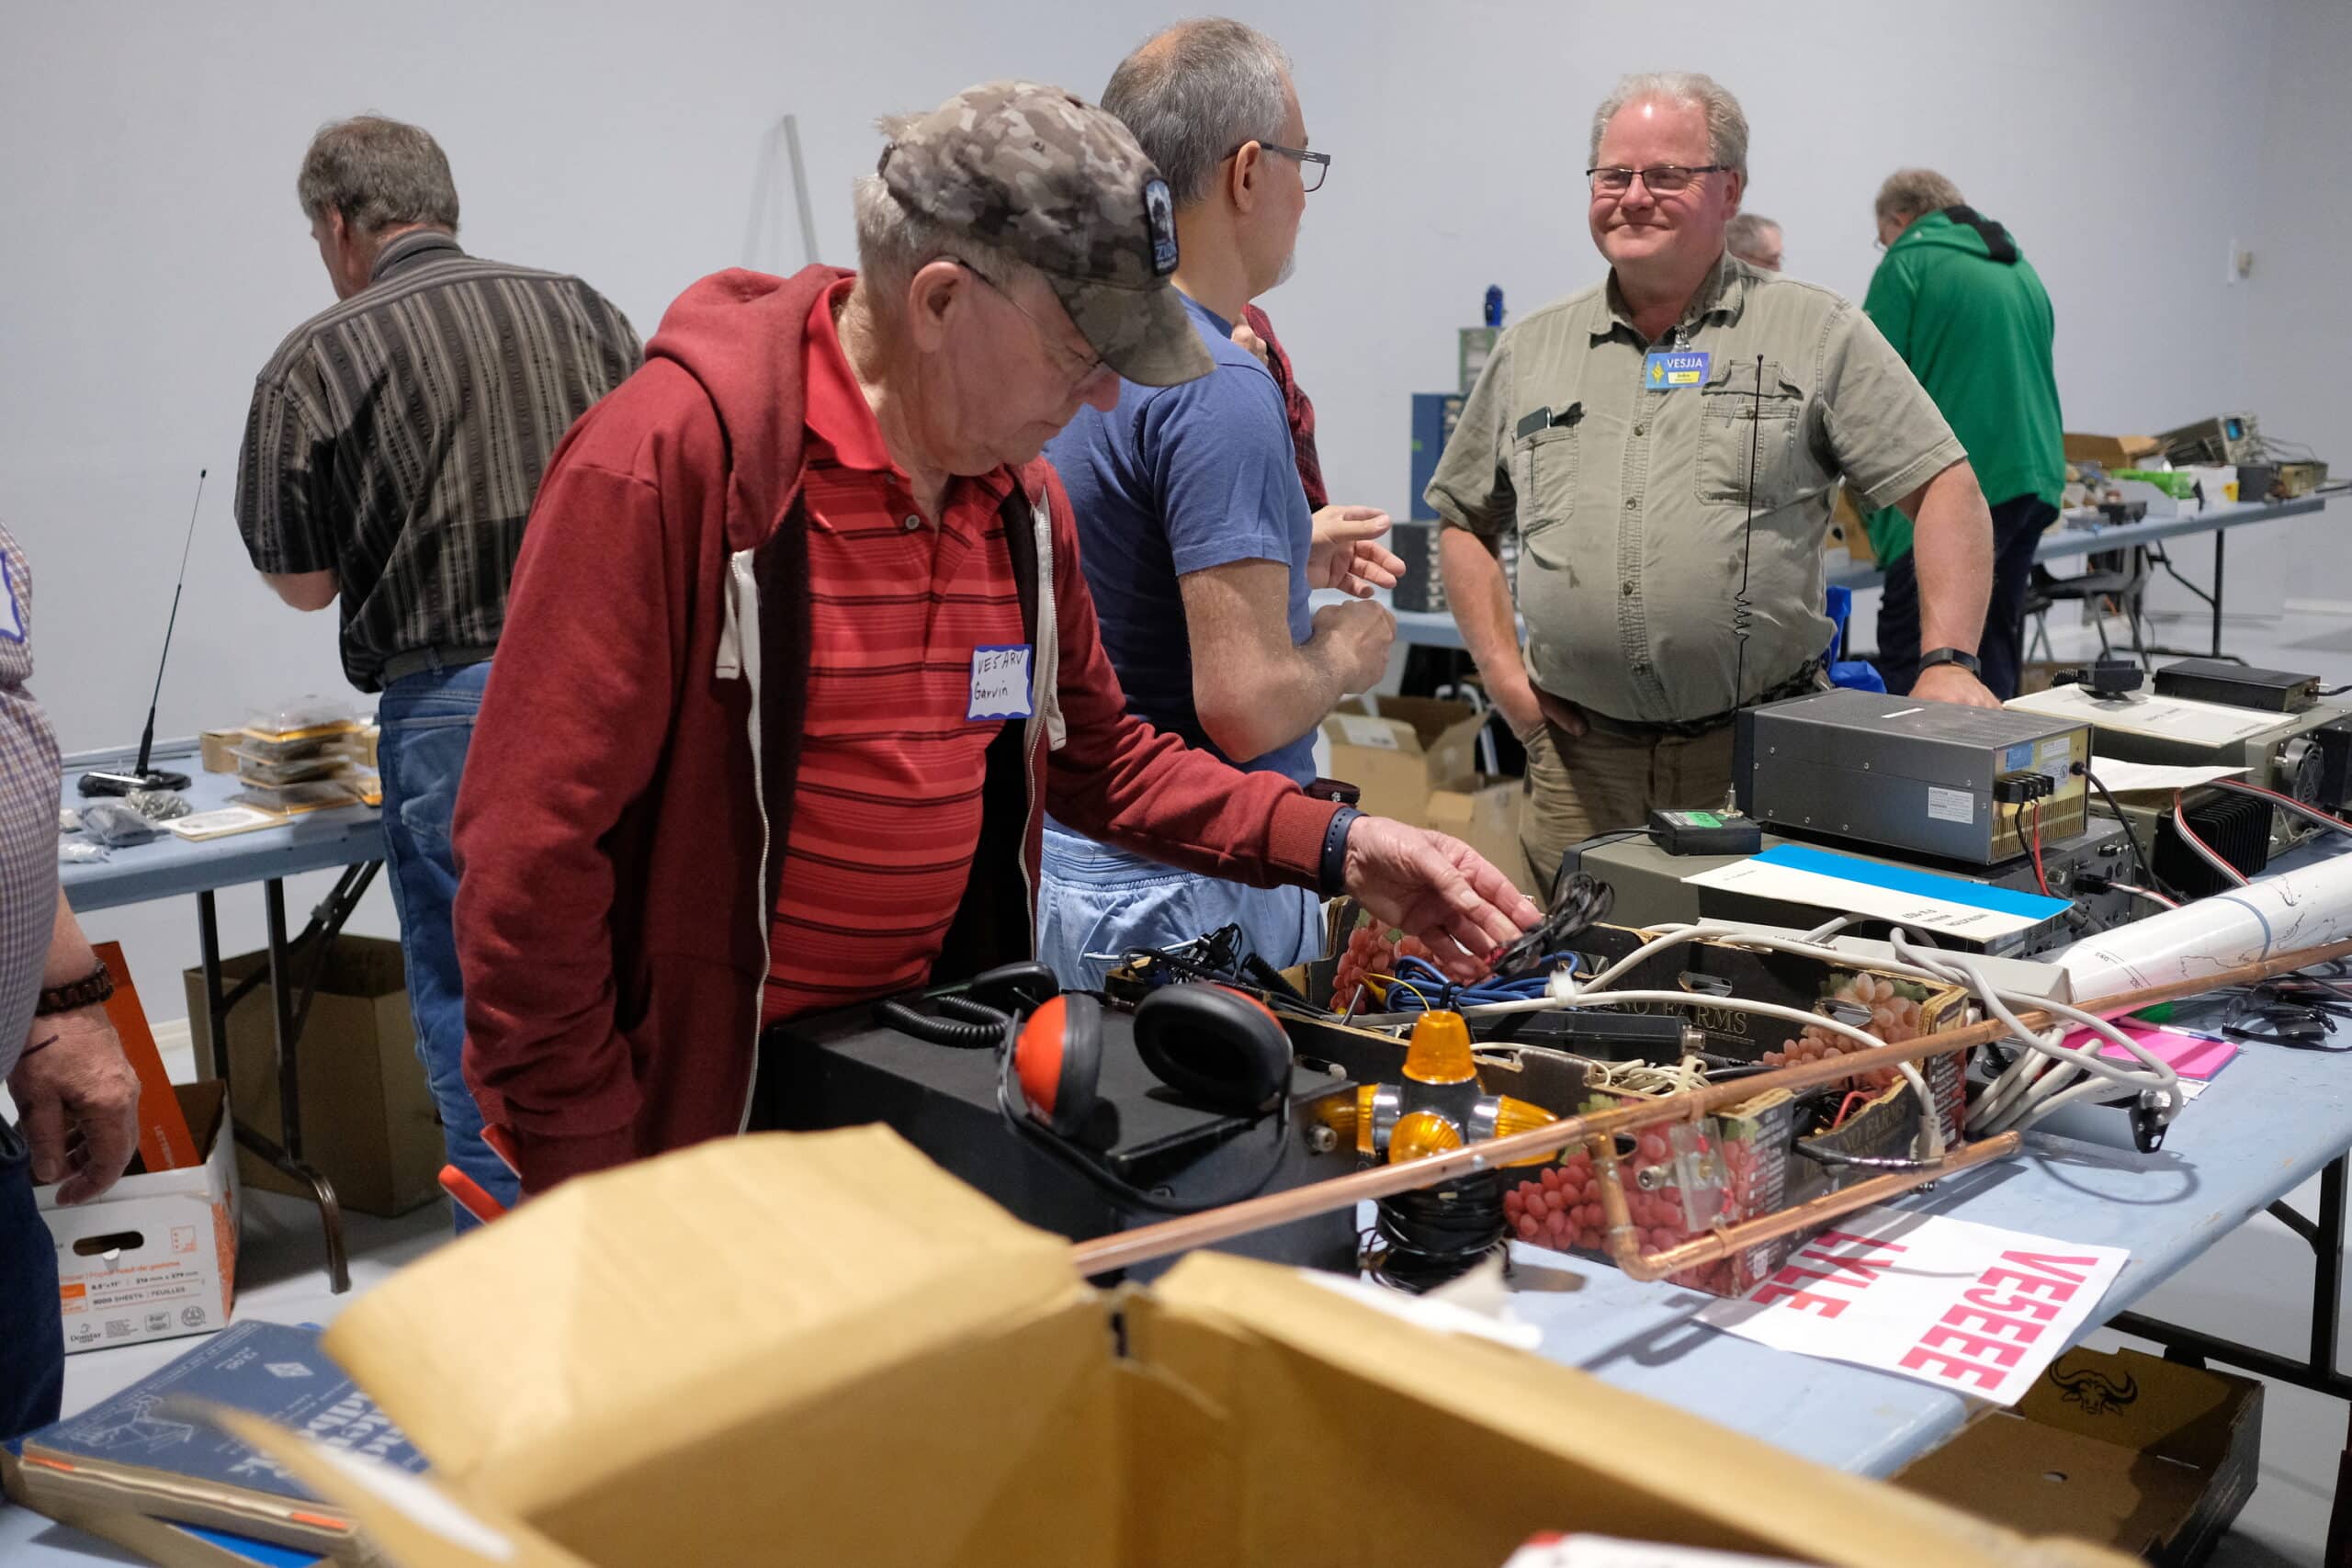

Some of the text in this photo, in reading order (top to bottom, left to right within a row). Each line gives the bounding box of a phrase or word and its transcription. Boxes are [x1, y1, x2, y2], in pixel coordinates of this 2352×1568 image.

[974, 680, 1008, 701] Garvin
[1747, 1229, 1910, 1319] LYLE
[1897, 1249, 2099, 1391] VE5EEE
